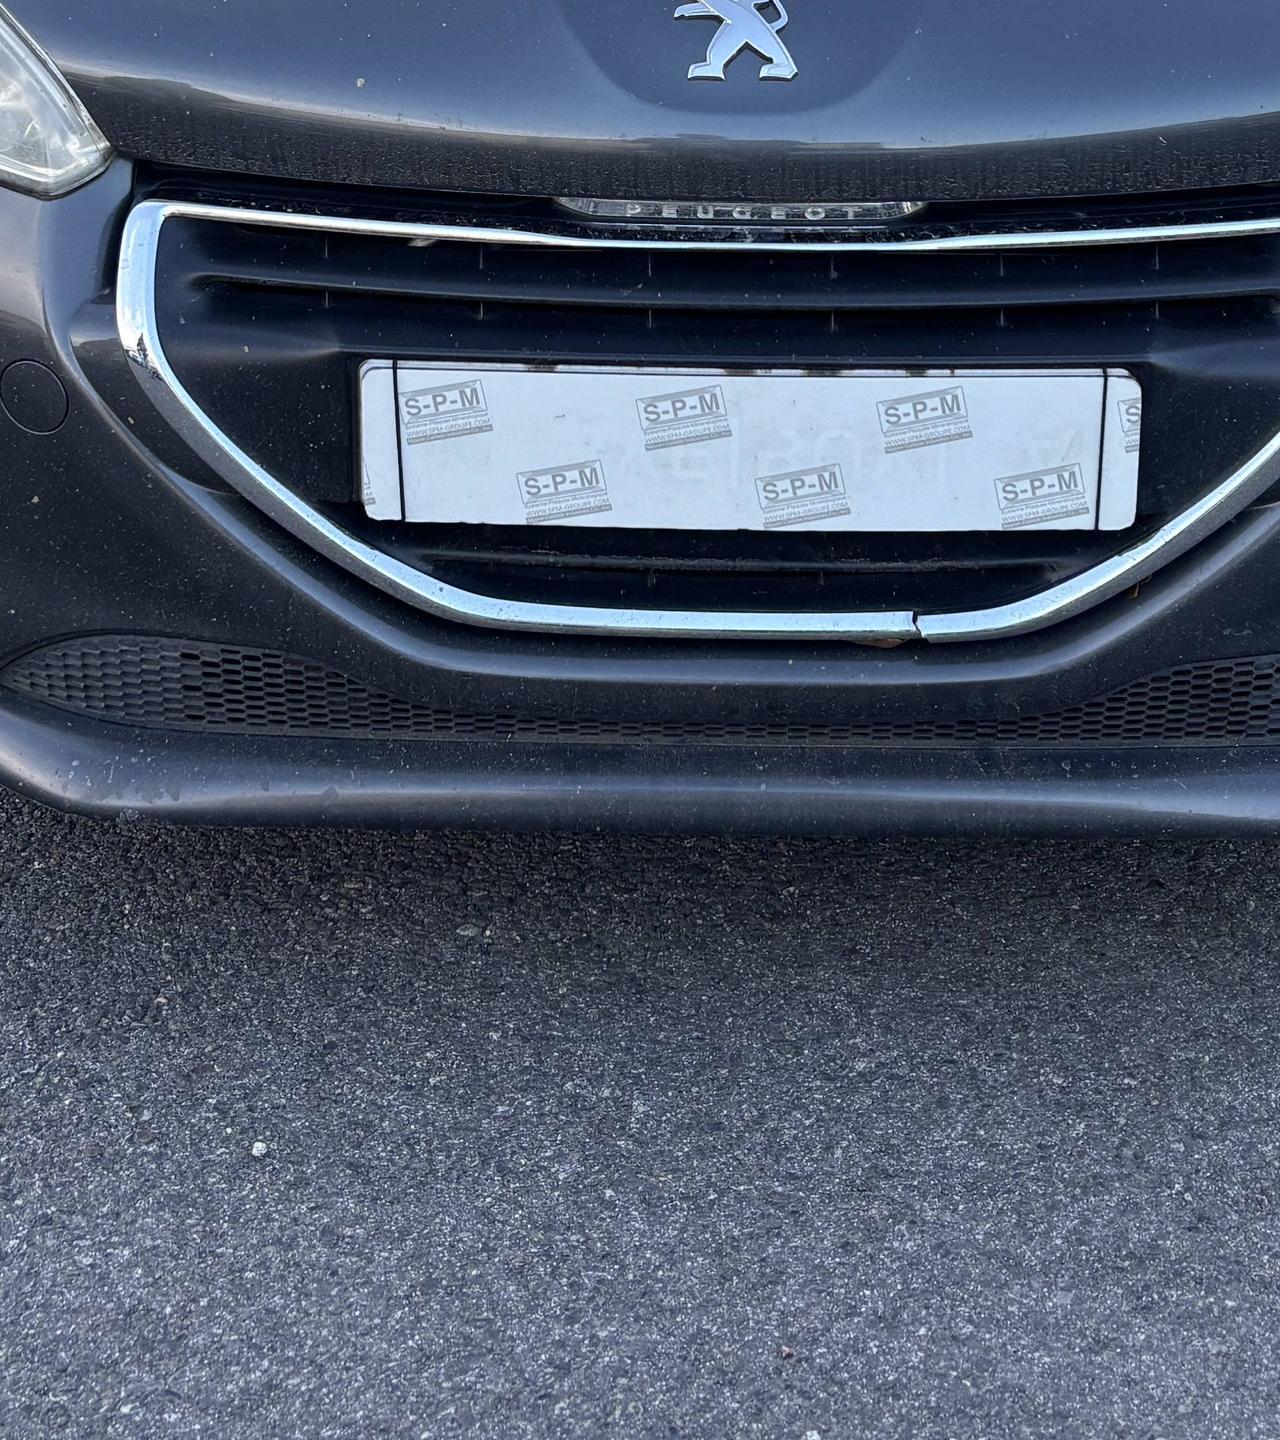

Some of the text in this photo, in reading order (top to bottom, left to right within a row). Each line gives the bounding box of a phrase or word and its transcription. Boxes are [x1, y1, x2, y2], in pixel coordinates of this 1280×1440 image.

[626, 203, 863, 220] PEUGEOT
[404, 387, 481, 416] S-P-M
[643, 391, 720, 422] S-P-M
[884, 393, 961, 425] S-P-M
[524, 467, 600, 496] S-P-M
[762, 471, 839, 501] S-P-M
[1001, 470, 1078, 502] S-P-M
